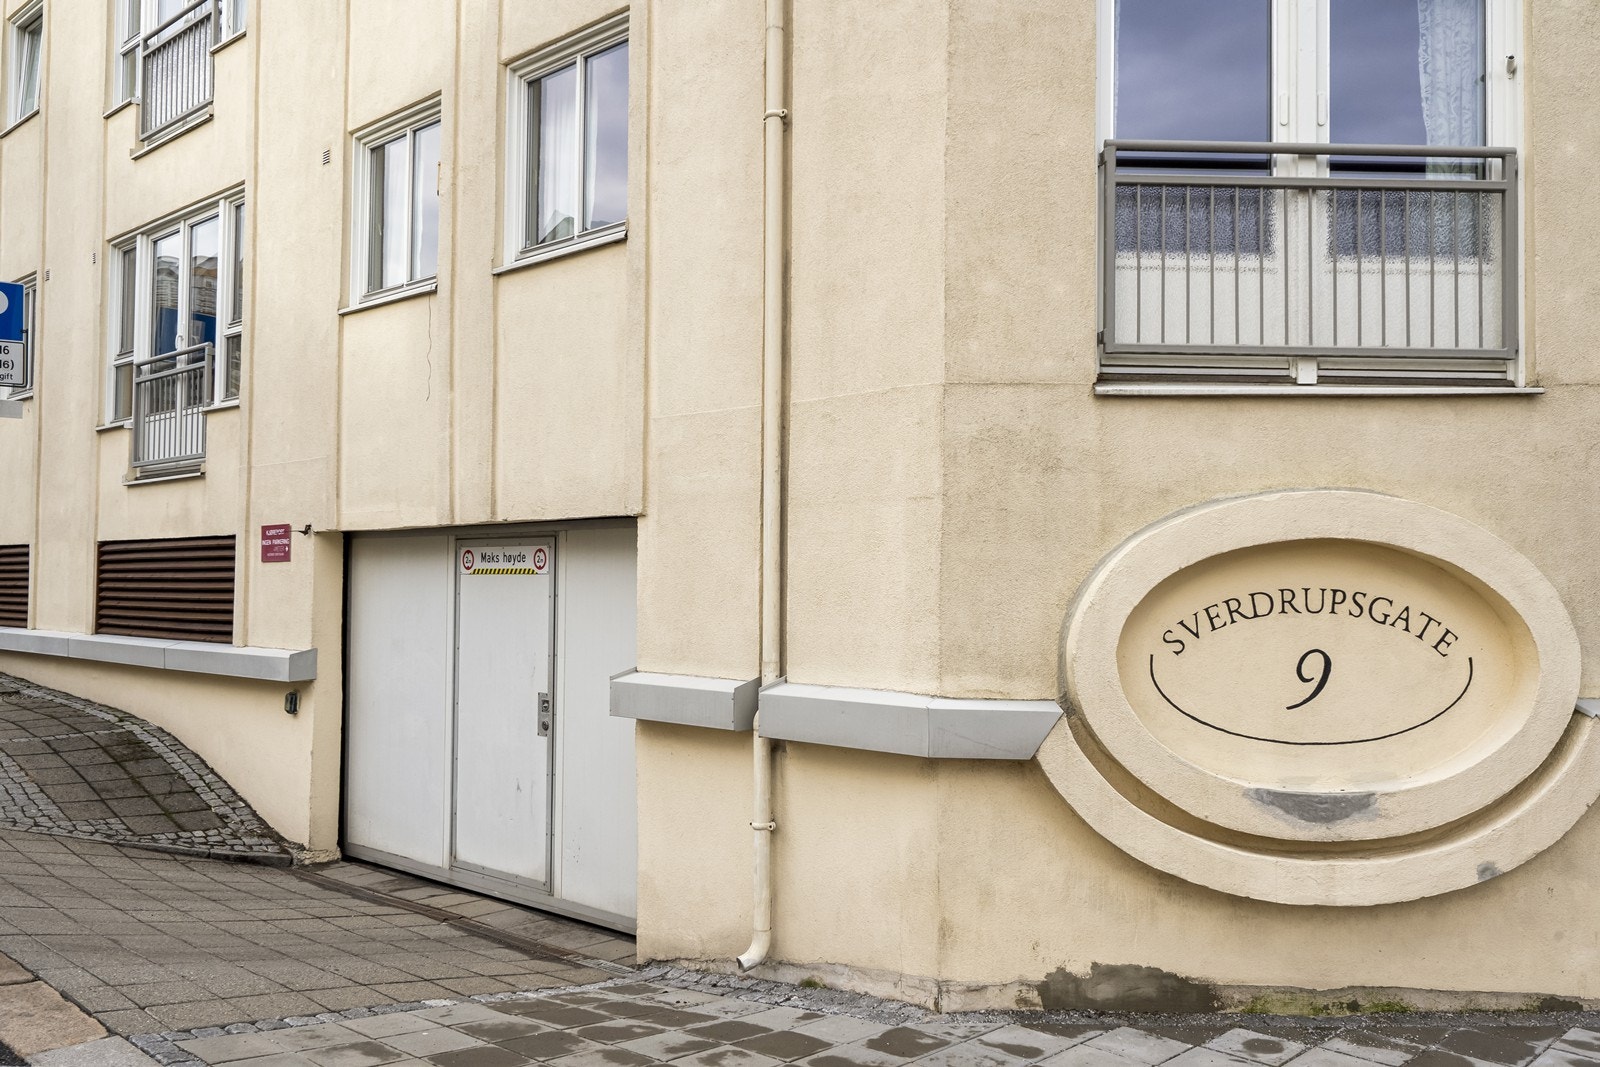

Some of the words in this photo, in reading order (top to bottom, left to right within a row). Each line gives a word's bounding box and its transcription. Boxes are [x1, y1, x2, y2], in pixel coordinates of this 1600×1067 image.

[481, 552, 500, 563] Maks
[503, 552, 526, 566] høyde
[1162, 587, 1459, 658] SVERDRUPSGATE
[1285, 648, 1332, 710] 9
